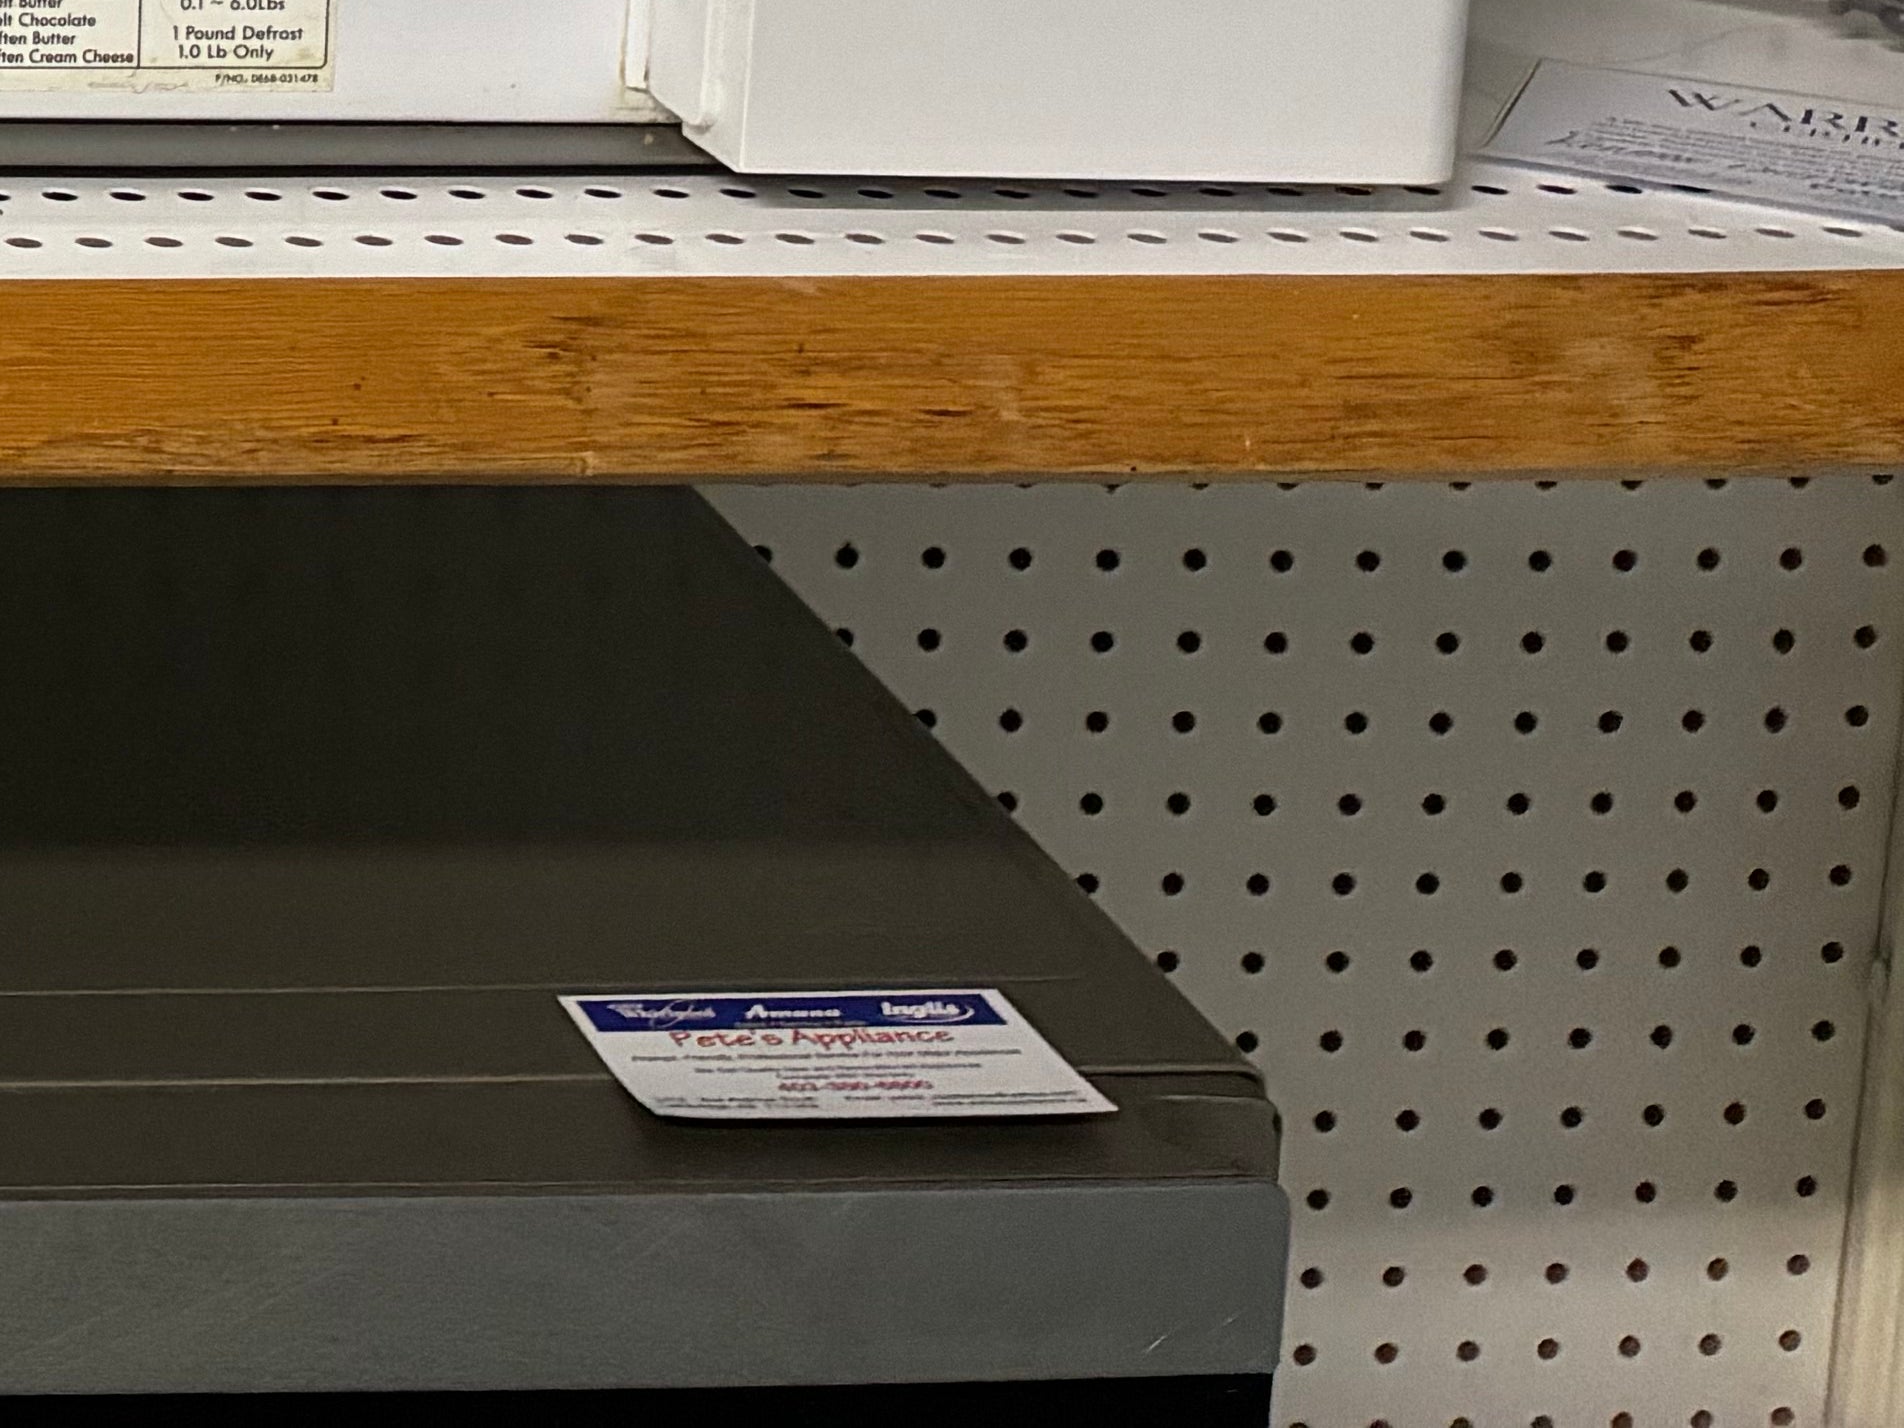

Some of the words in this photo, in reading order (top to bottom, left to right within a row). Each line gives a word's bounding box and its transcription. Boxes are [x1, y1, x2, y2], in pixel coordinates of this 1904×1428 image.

[173, 25, 178, 40] 1
[186, 25, 235, 40] Pound
[243, 25, 303, 40] Defrost
[179, 44, 201, 59] 1.0
[208, 44, 227, 58] Lb
[233, 44, 274, 62] Only
[669, 1030, 782, 1048] Pete's
[791, 1028, 956, 1051] Appliance
